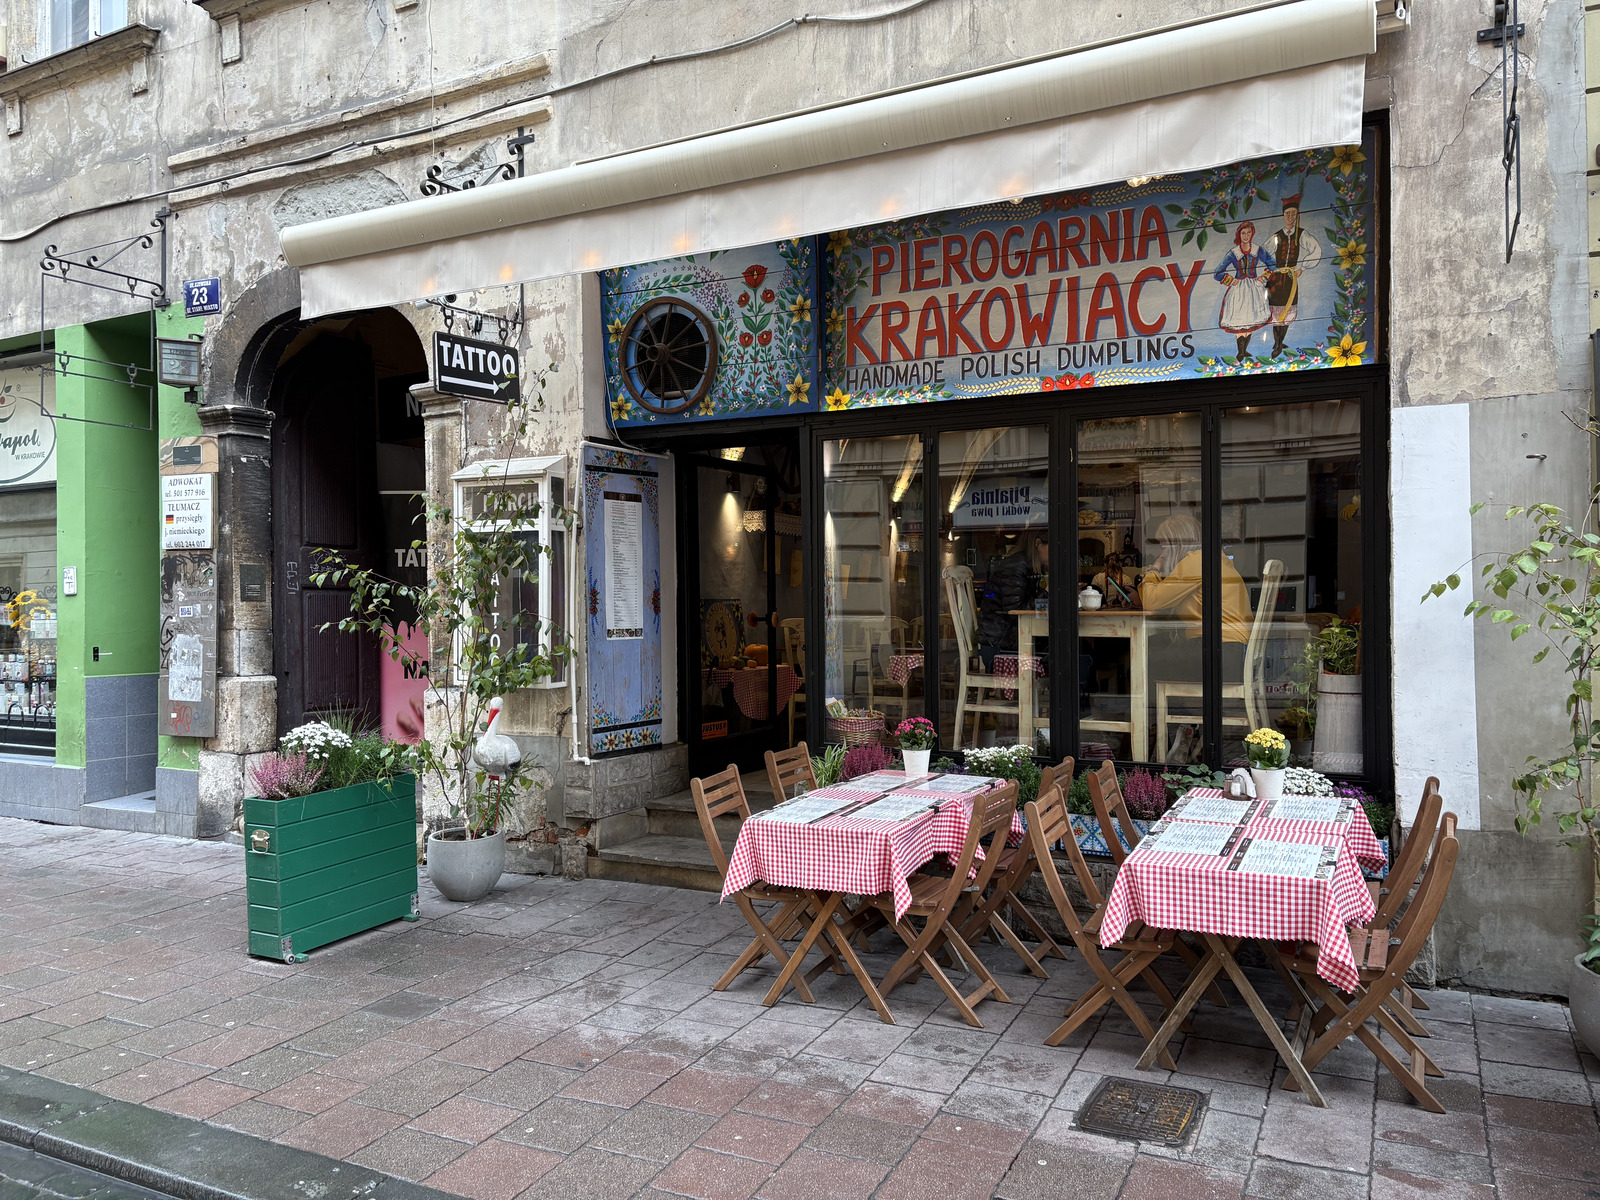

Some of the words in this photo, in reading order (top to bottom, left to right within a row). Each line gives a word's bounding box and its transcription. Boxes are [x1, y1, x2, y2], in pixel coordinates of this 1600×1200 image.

[871, 205, 1172, 297] PIEROGARNIA
[192, 287, 208, 306] 23
[846, 259, 1207, 367] KRAKOWIACY
[440, 340, 516, 378] TATTOO
[846, 359, 946, 392] HANDMADE
[961, 350, 1041, 381] POLISH
[1056, 334, 1196, 371] DUMPLINGS
[0, 429, 40, 456] apol
[21, 451, 45, 460] KRAKOWIE
[168, 477, 204, 487] ADWOKAT
[184, 489, 194, 497] 577
[168, 502, 200, 512] TŁUMACZ
[175, 514, 203, 525] przysięgły
[169, 527, 205, 537] niemieckiego
